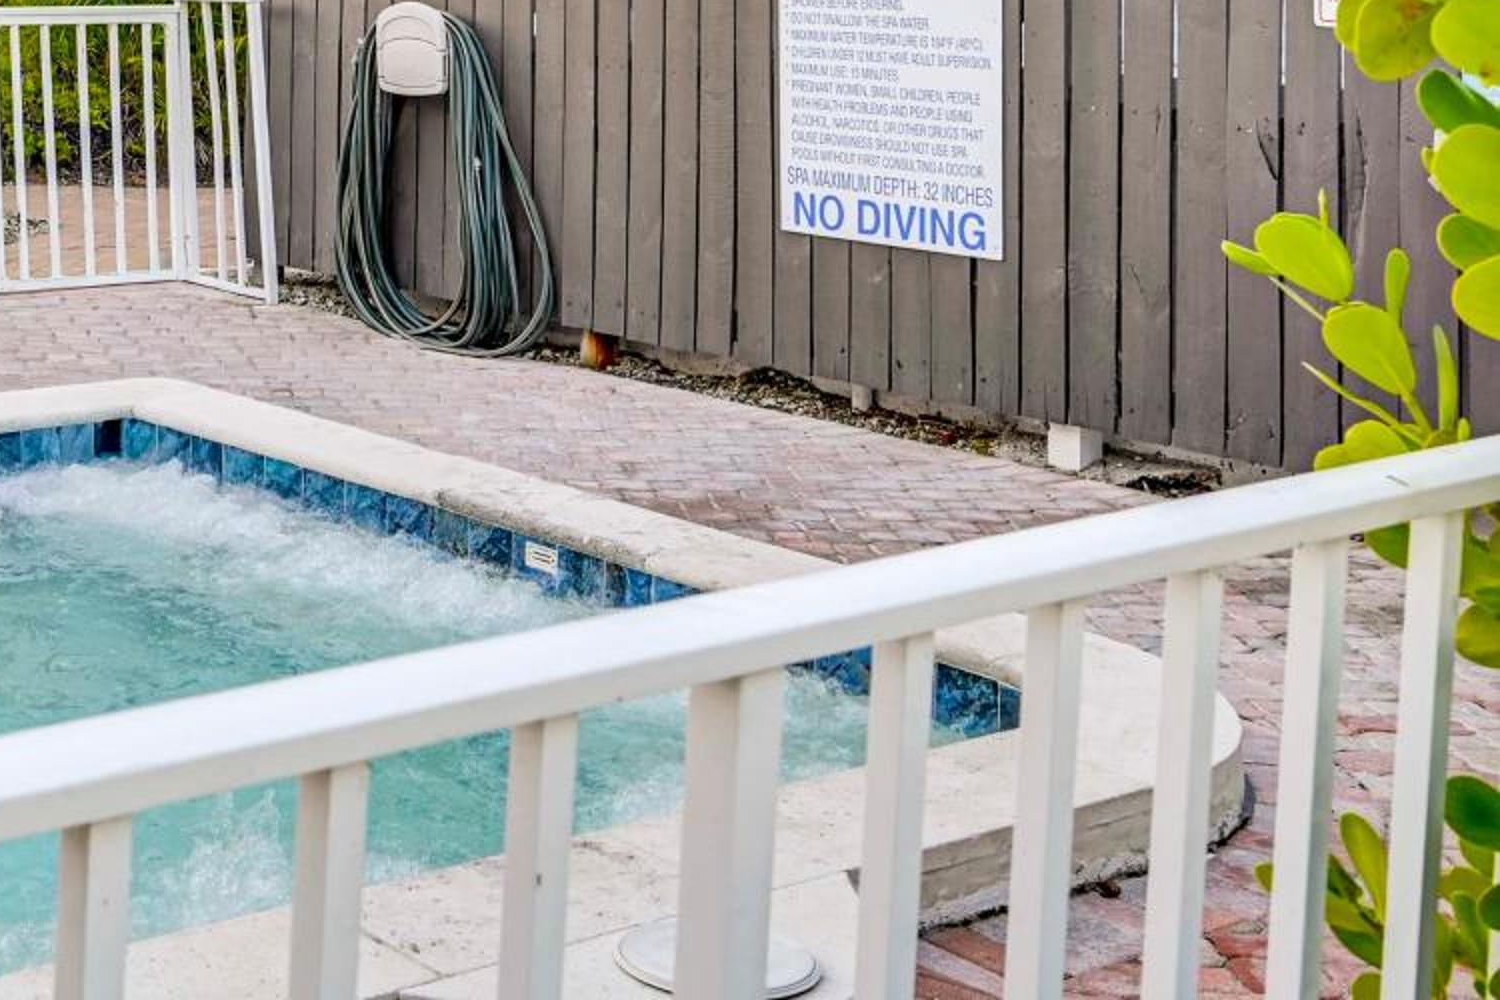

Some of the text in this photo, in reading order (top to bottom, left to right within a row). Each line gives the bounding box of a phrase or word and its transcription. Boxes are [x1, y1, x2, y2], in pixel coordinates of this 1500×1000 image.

[787, 165, 993, 208] SPA MAXIMUM DEPTH: 32 INCHES
[793, 191, 986, 251] NO DIVING
